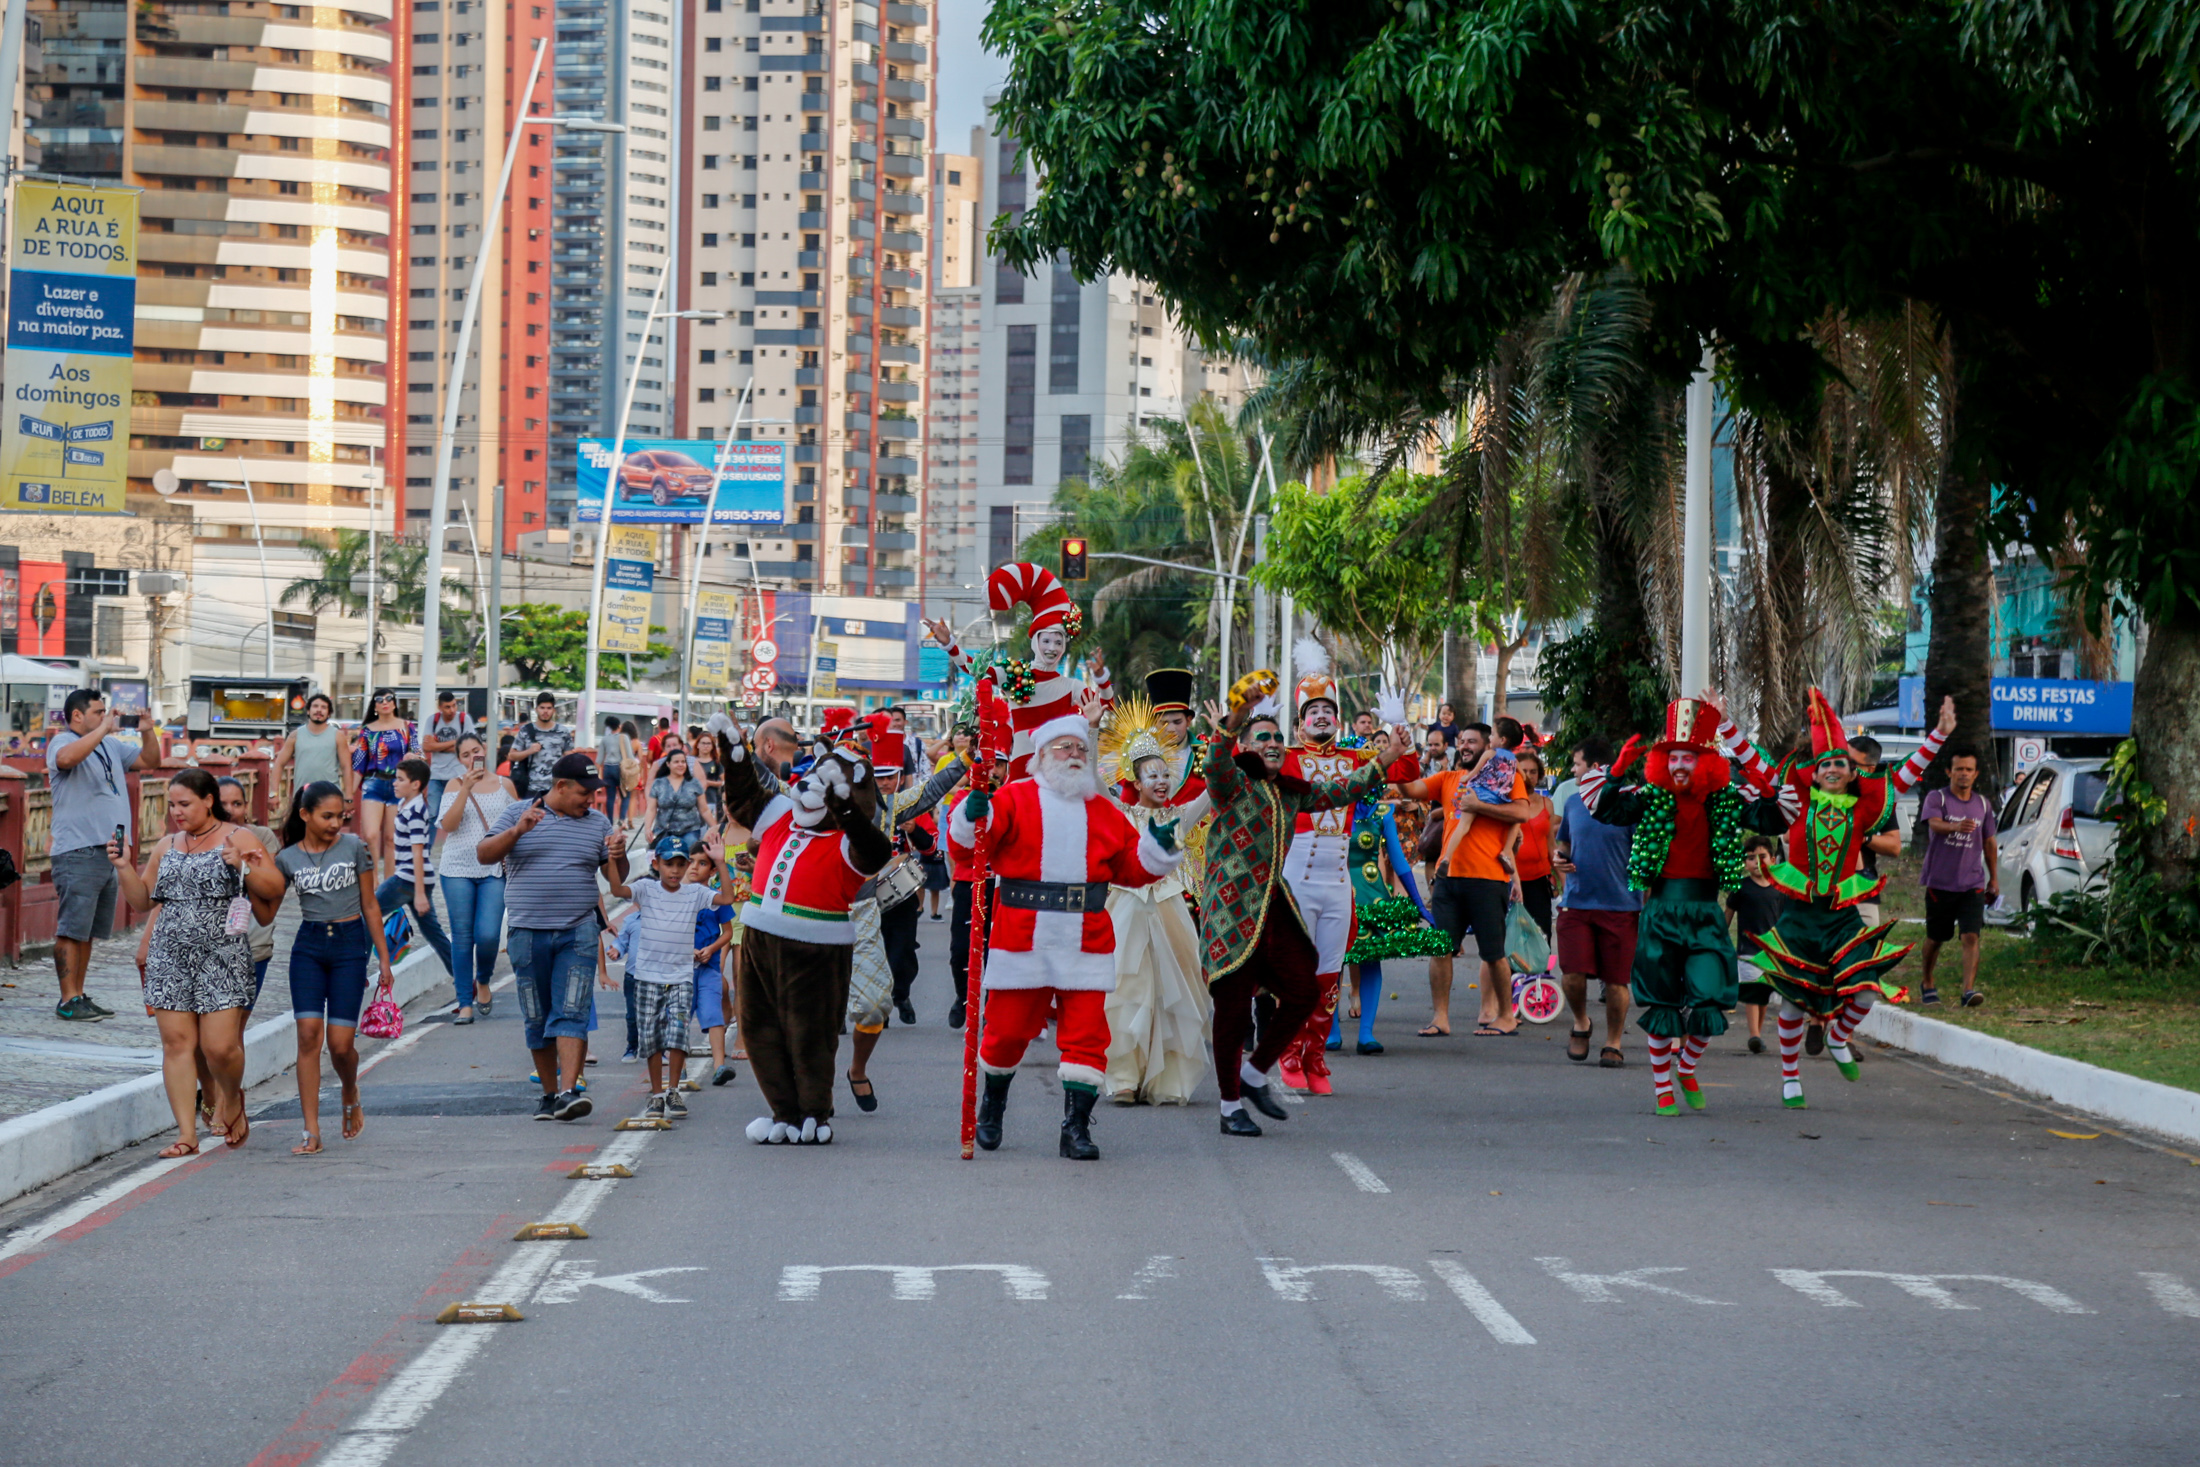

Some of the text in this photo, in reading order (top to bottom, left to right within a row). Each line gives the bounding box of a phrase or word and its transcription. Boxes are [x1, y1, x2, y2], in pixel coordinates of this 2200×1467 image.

[51, 196, 104, 216] AQUI
[35, 218, 119, 239] A RUA É
[23, 238, 129, 262] DE TODOS.
[43, 283, 99, 302] Lazer e
[36, 302, 104, 320] diversão
[18, 320, 124, 340] na maior paz.
[49, 363, 90, 382] Aos
[16, 383, 120, 410] domingos
[31, 422, 53, 438] RUA
[73, 426, 108, 439] DE TODOS
[749, 445, 782, 454] ZERO
[732, 455, 747, 463] 36
[747, 455, 782, 463] VEZES
[729, 473, 747, 481] SEU
[748, 473, 782, 481] USADO
[52, 490, 104, 508] BELÉM
[714, 511, 782, 521] 99150-3796
[624, 531, 645, 539] AQUI
[1993, 686, 2096, 705] CLASS FESTAS
[2025, 747, 2035, 759] E
[302, 866, 320, 875] Enjoy
